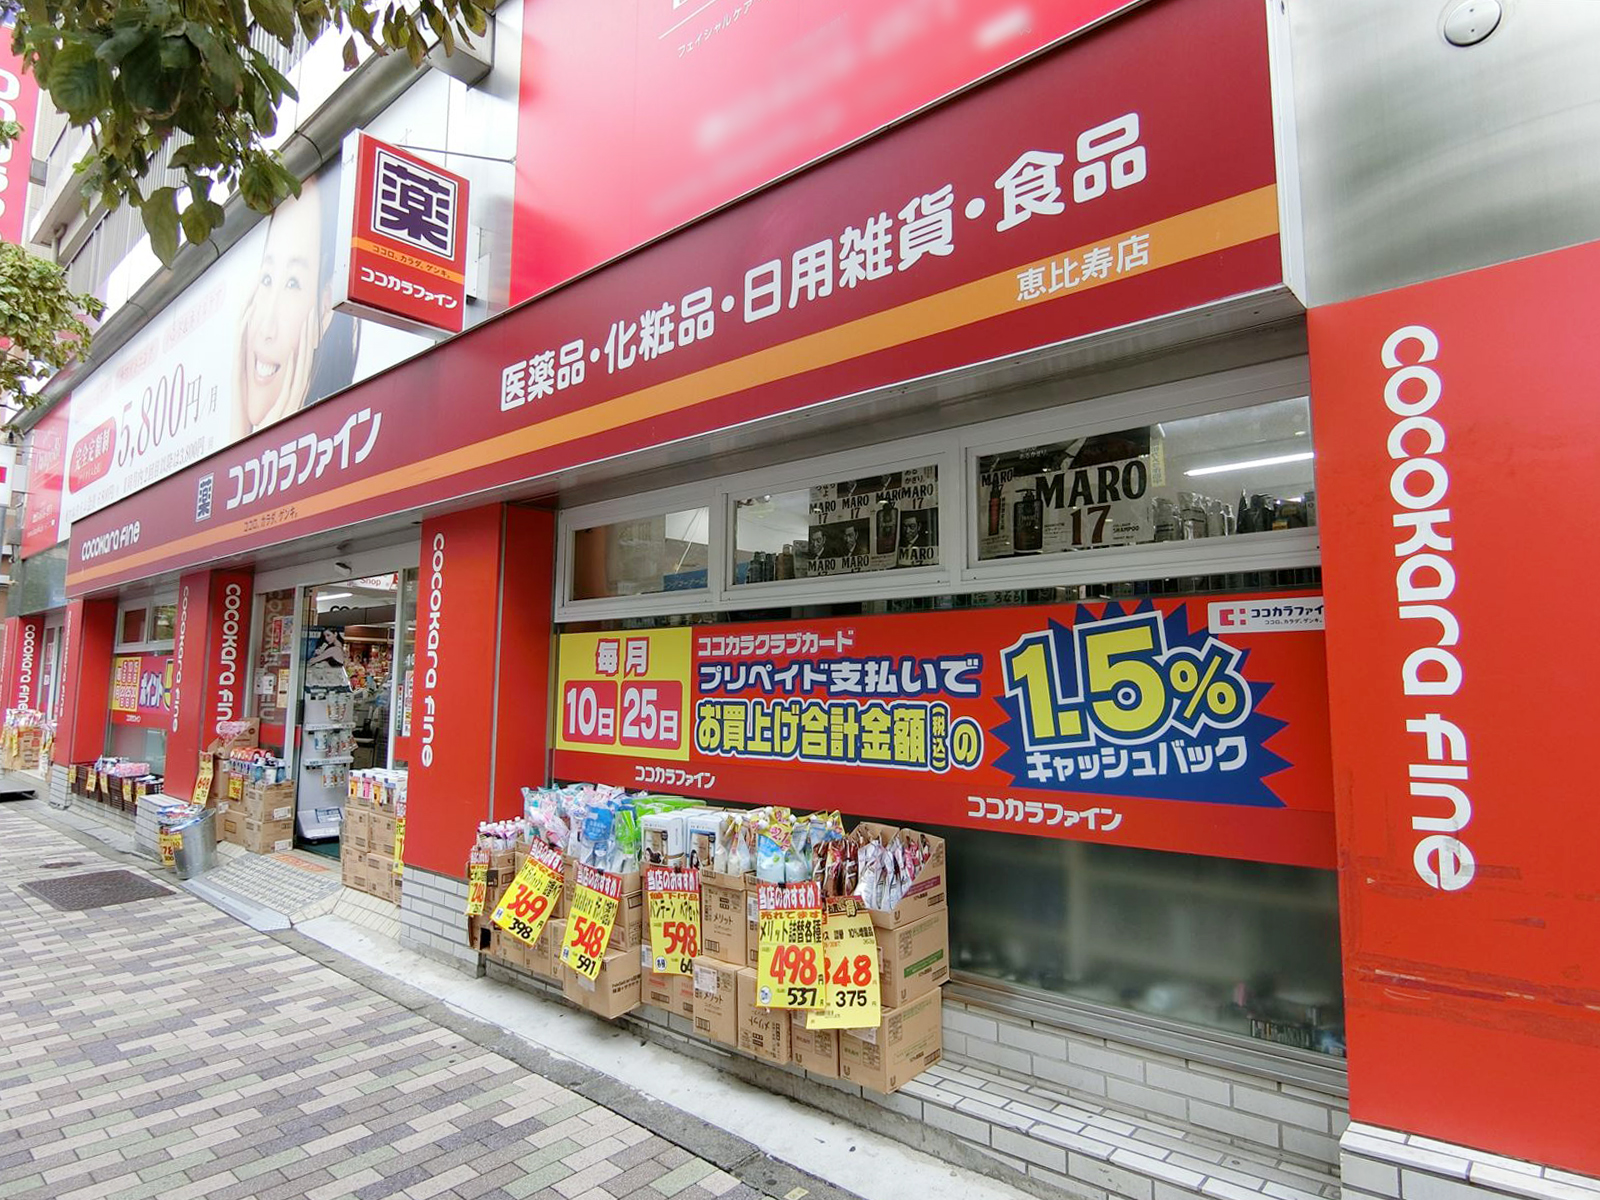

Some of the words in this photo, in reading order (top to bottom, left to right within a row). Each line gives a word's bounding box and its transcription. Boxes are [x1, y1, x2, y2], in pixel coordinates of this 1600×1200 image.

[379, 160, 451, 252] 薬
[500, 112, 1149, 413] 医薬品・化粧品・日用雑貨・食品
[1016, 233, 1150, 302] 恵比寿店
[360, 266, 459, 310] ココカラファイン
[226, 407, 382, 510] ココカラファイン
[981, 469, 1014, 487] MARO
[842, 494, 869, 510] MARO
[912, 498, 923, 510] 17
[1035, 459, 1148, 510] MARO
[818, 513, 829, 525] 17
[850, 508, 861, 520] 17
[1069, 504, 1112, 546] 17
[1380, 324, 1463, 697] cocokara
[81, 529, 120, 561] cocokara
[119, 520, 141, 547] fine
[899, 548, 934, 562] MARO
[808, 558, 836, 572] MARO
[842, 554, 869, 570] MARO
[425, 533, 445, 690] cocokara
[20, 624, 36, 685] cocokara
[217, 584, 242, 686] cocokara
[698, 629, 854, 657] ココカラクラブカード
[596, 639, 650, 676] 毎月
[700, 656, 979, 693] プリペイド支払いで
[1011, 625, 1238, 740] 1.5%
[421, 695, 437, 768] fine
[566, 686, 614, 738] 10日
[622, 687, 691, 742] 25日
[699, 703, 927, 763] お買上げ合計金額
[955, 723, 979, 764] の
[635, 765, 716, 788] ココカラファイン
[1027, 736, 1248, 784] キャッシュバック
[967, 795, 1122, 832] ココカラファイン
[1405, 712, 1475, 892] fine
[507, 884, 548, 924] 369
[508, 917, 533, 940] 398
[571, 915, 606, 959] 548
[663, 921, 698, 958] 598
[576, 954, 597, 976] 591
[680, 957, 694, 975] 64
[770, 944, 817, 985] 498
[787, 986, 817, 1007] 537
[836, 990, 867, 1007] 375
